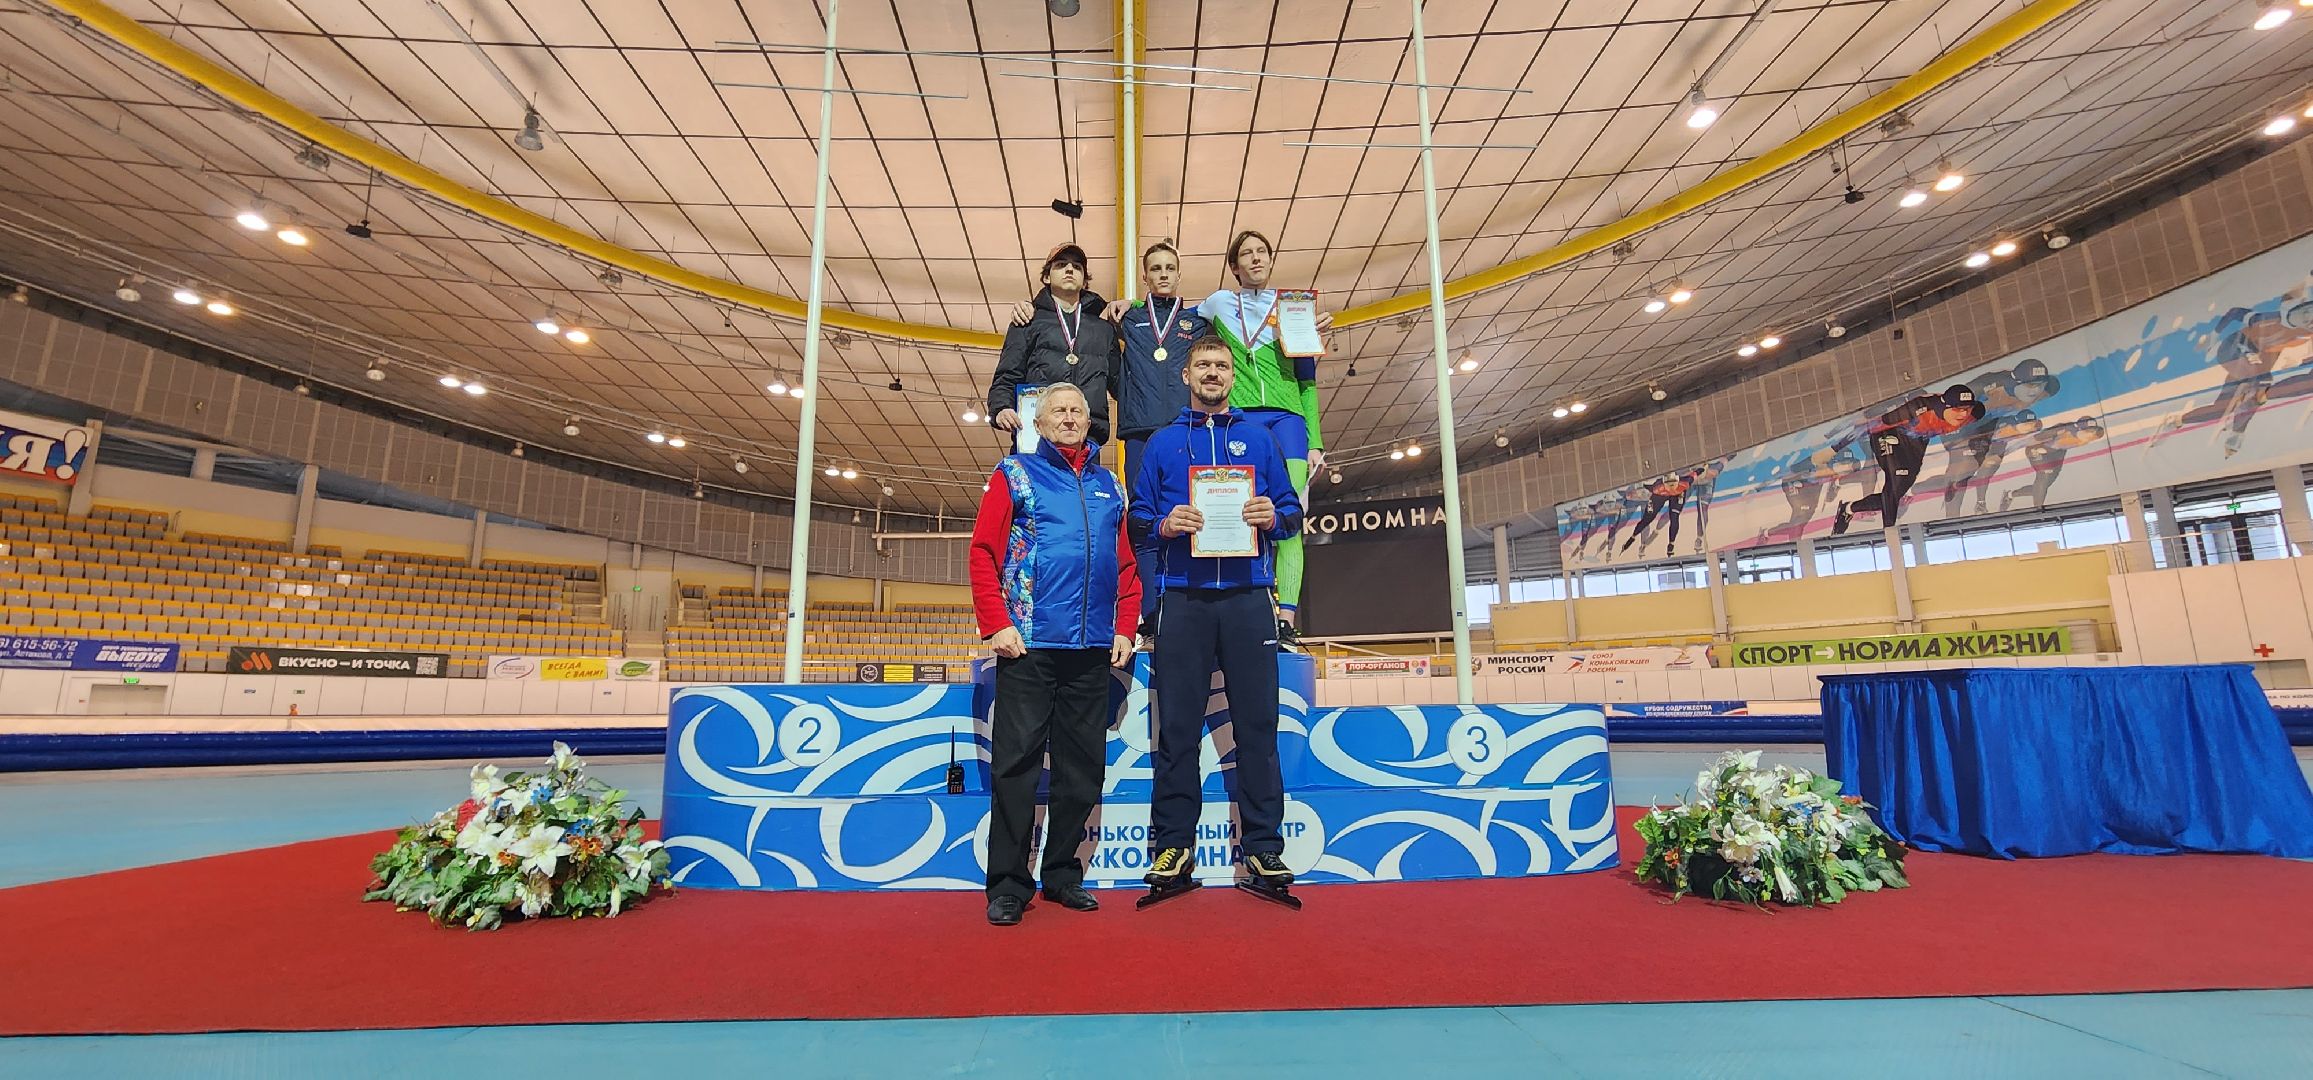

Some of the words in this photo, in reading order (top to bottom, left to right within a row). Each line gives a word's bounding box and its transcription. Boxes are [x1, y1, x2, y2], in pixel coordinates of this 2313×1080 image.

[0, 428, 87, 480] Я!
[1302, 506, 1447, 535] КОЛОМНА
[1739, 644, 1814, 665] СПОРТ
[1837, 637, 1941, 662] НОРМА
[1945, 631, 2061, 657] ЖИЗНИ
[95, 650, 168, 663] ВЫСОТА
[1487, 654, 1555, 665] МИНСПОРТ
[1592, 652, 1614, 660] СОЮЗ
[278, 656, 338, 668] ВКУСНО
[365, 659, 411, 670] ТОЧКА
[547, 661, 582, 671] ВСЕГДА
[1349, 661, 1406, 671] ЛОР-ОРГАНОВ
[1498, 664, 1546, 674] РОССИИ
[573, 669, 603, 679] ВАМИ!
[1138, 702, 1152, 740] 1
[796, 716, 821, 754] 2
[1466, 725, 1489, 763] 3
